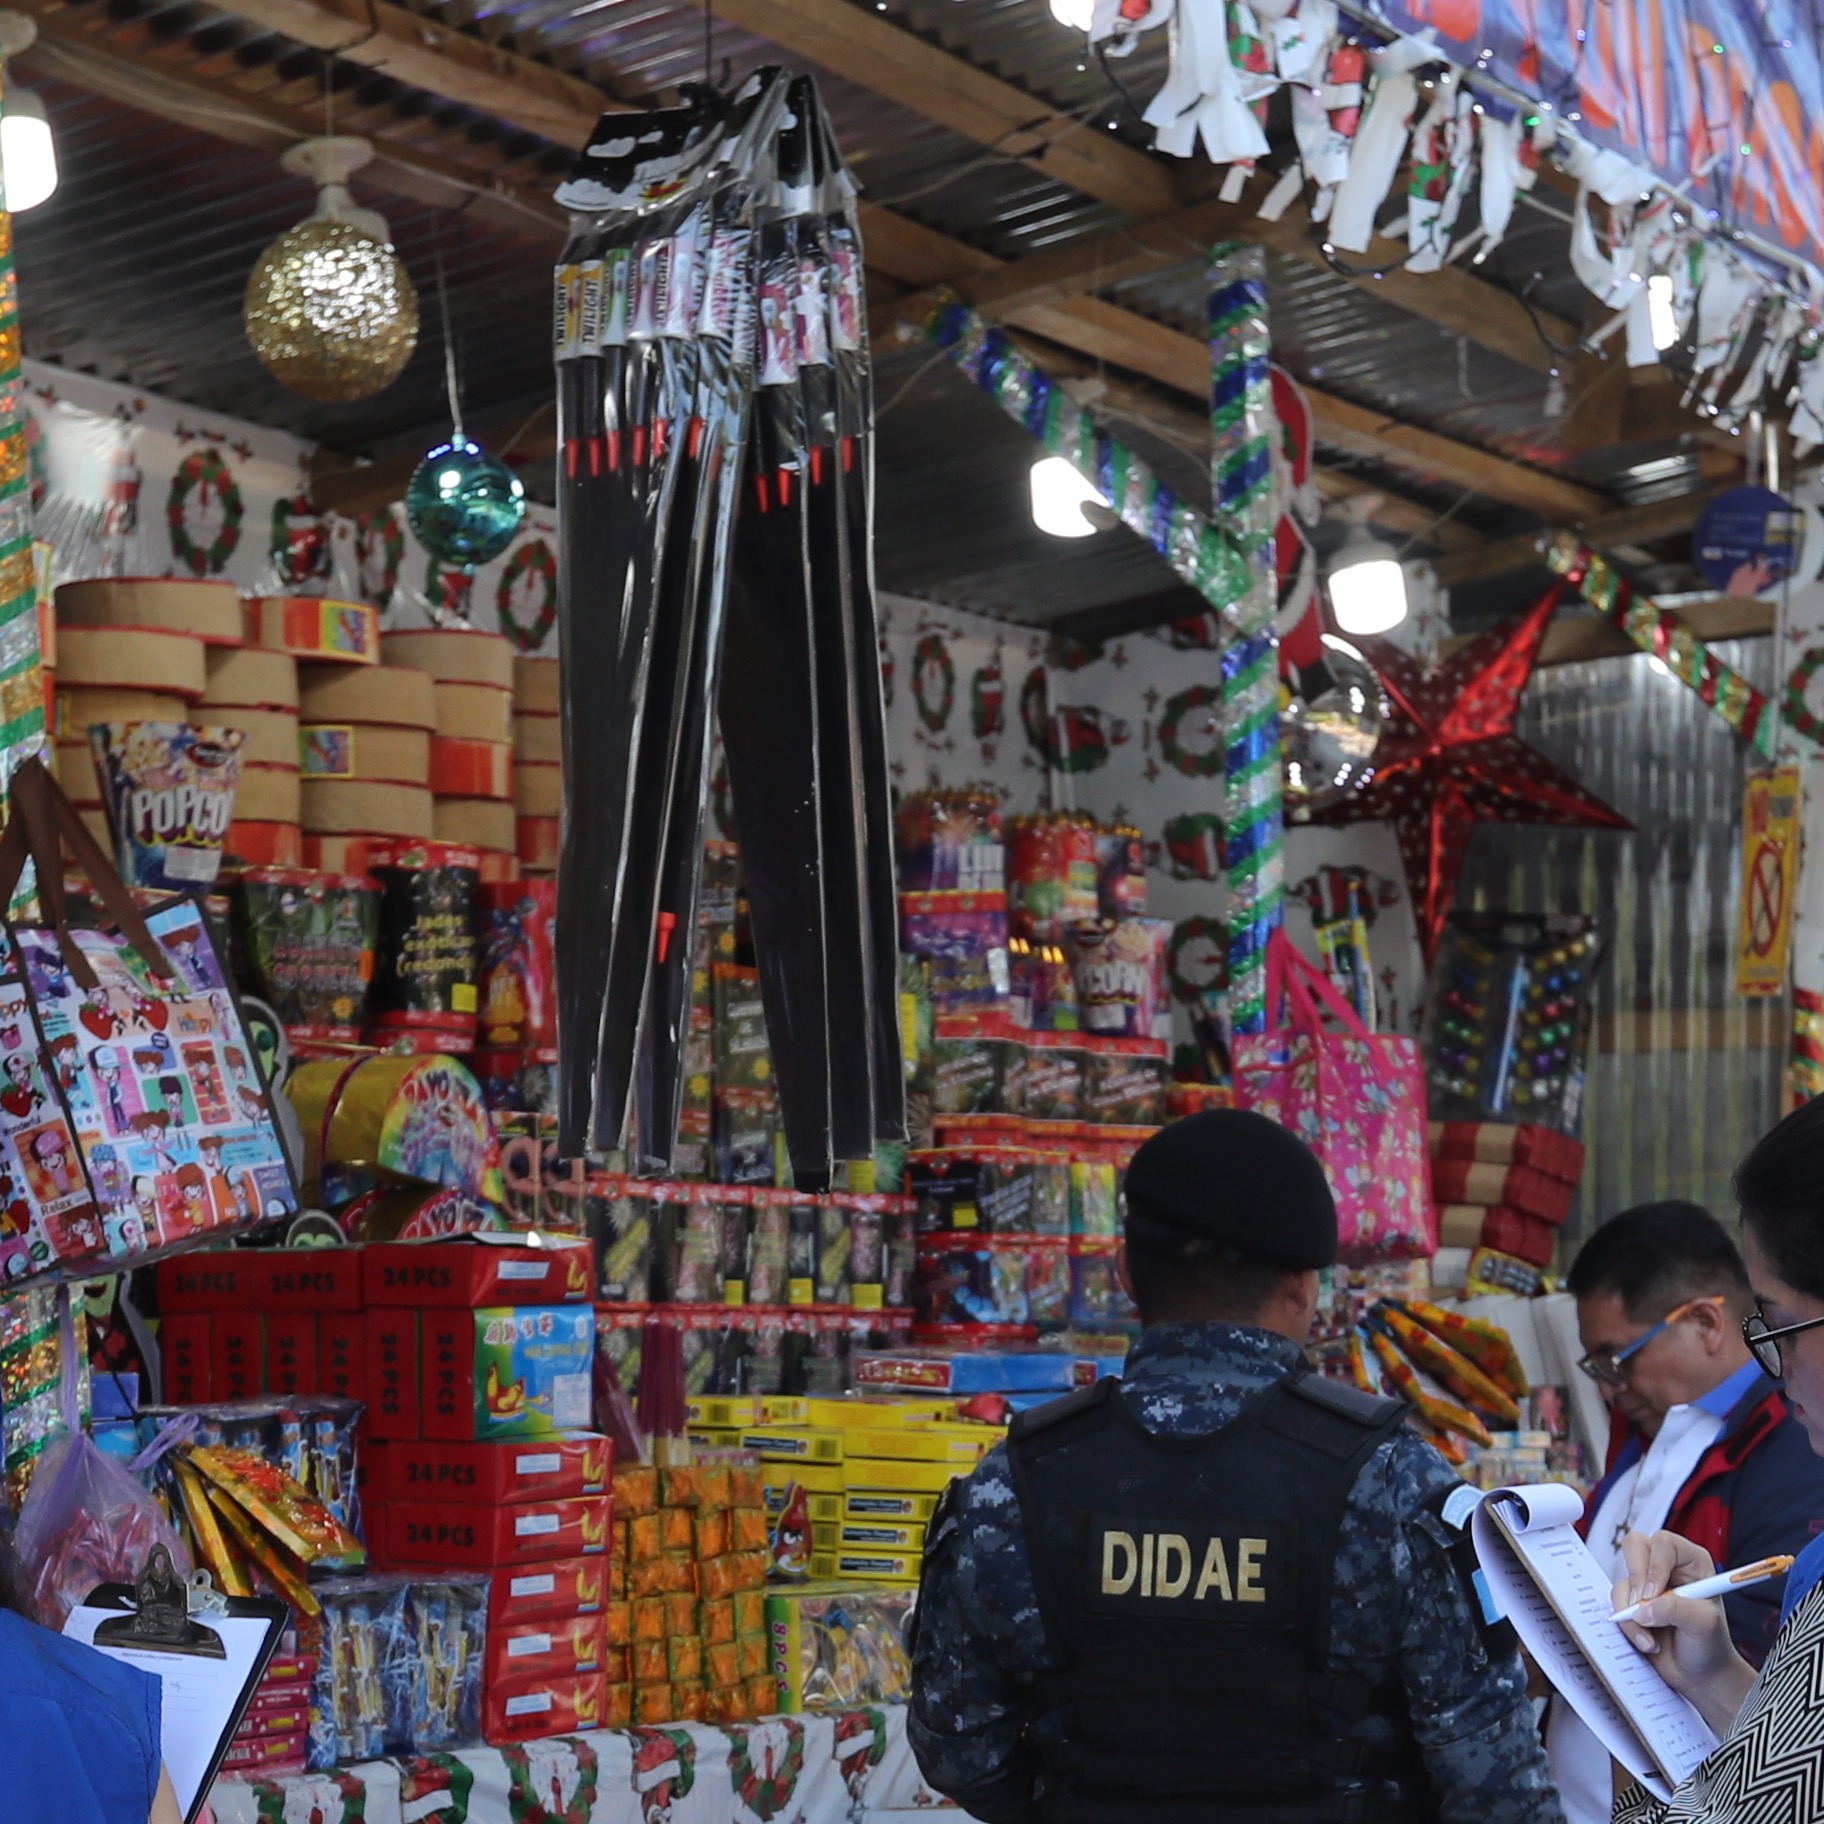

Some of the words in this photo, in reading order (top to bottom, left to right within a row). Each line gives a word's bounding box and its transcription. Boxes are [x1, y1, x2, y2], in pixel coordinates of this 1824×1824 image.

[582, 280, 600, 343] TWILIGHT
[40, 1200, 73, 1217] Relax
[1101, 1531, 1267, 1603] DIDAE
